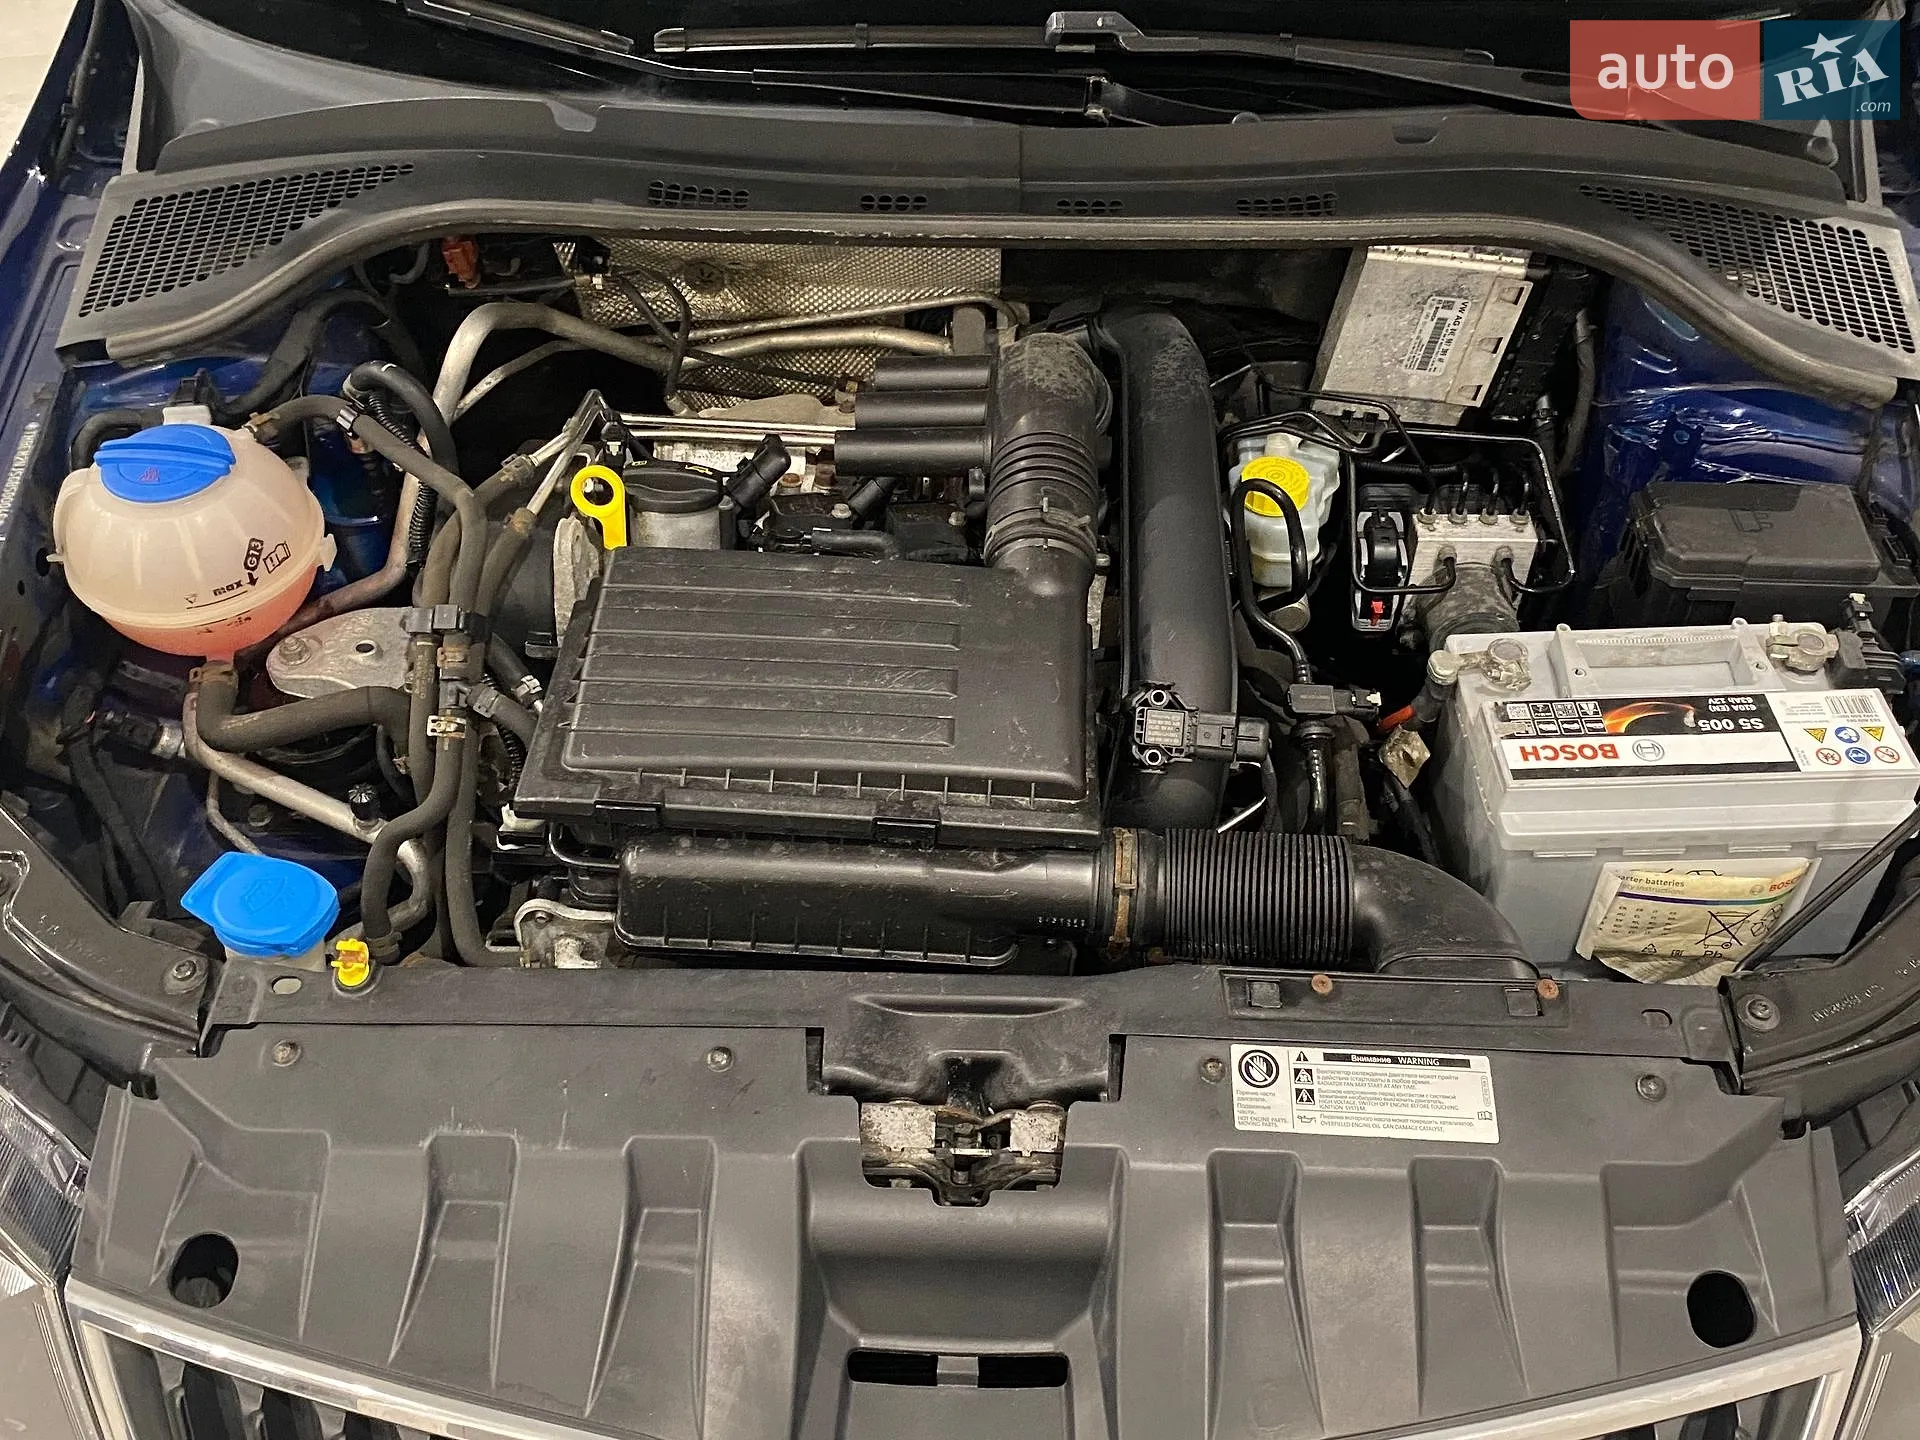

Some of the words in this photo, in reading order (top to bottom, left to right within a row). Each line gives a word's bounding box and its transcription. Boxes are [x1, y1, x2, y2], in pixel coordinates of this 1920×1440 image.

[1458, 302, 1469, 314] VW
[1452, 316, 1462, 326] AG
[247, 543, 262, 567] G13
[213, 580, 243, 596] max
[1697, 719, 1735, 731] 005
[1738, 718, 1765, 730] S5
[1519, 743, 1620, 762] BOSCH
[1645, 878, 1685, 888] batteries
[1351, 1055, 1392, 1064] Внимание
[1398, 1057, 1440, 1066] WARNING
